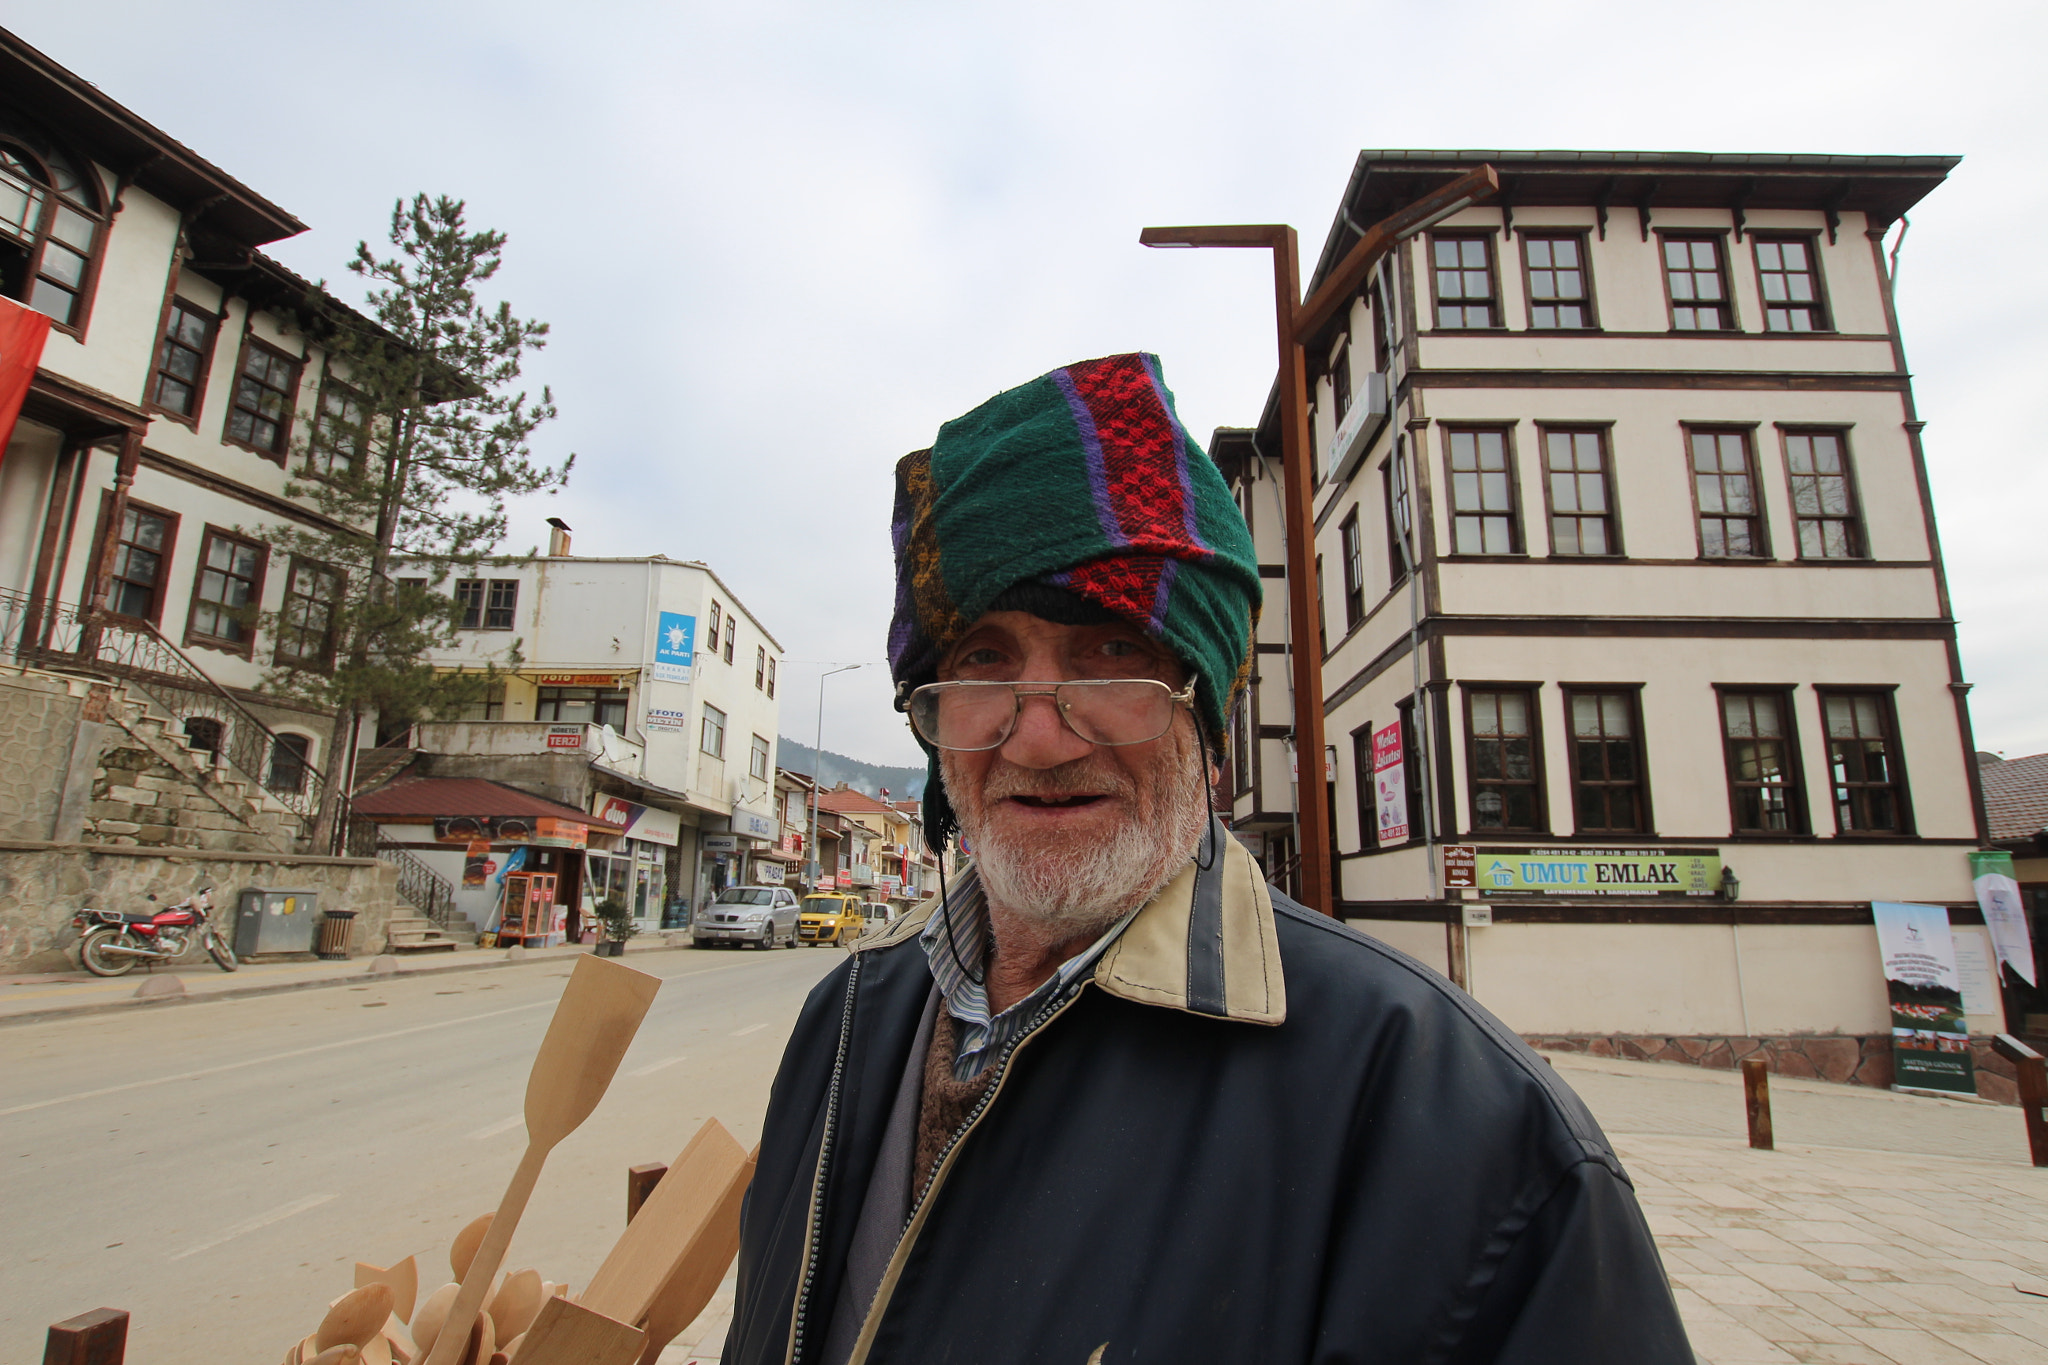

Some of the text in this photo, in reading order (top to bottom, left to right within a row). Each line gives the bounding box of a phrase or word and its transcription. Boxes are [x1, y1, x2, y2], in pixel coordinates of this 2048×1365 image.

[542, 674, 572, 682] FOTO
[656, 710, 683, 718] FOTO
[550, 736, 579, 746] TERZİ
[604, 802, 627, 826] duo
[749, 817, 769, 835] BEKO
[707, 840, 732, 848] BEKO
[1520, 863, 1679, 883] UMUT EMLAK
[1493, 874, 1512, 886] UE
